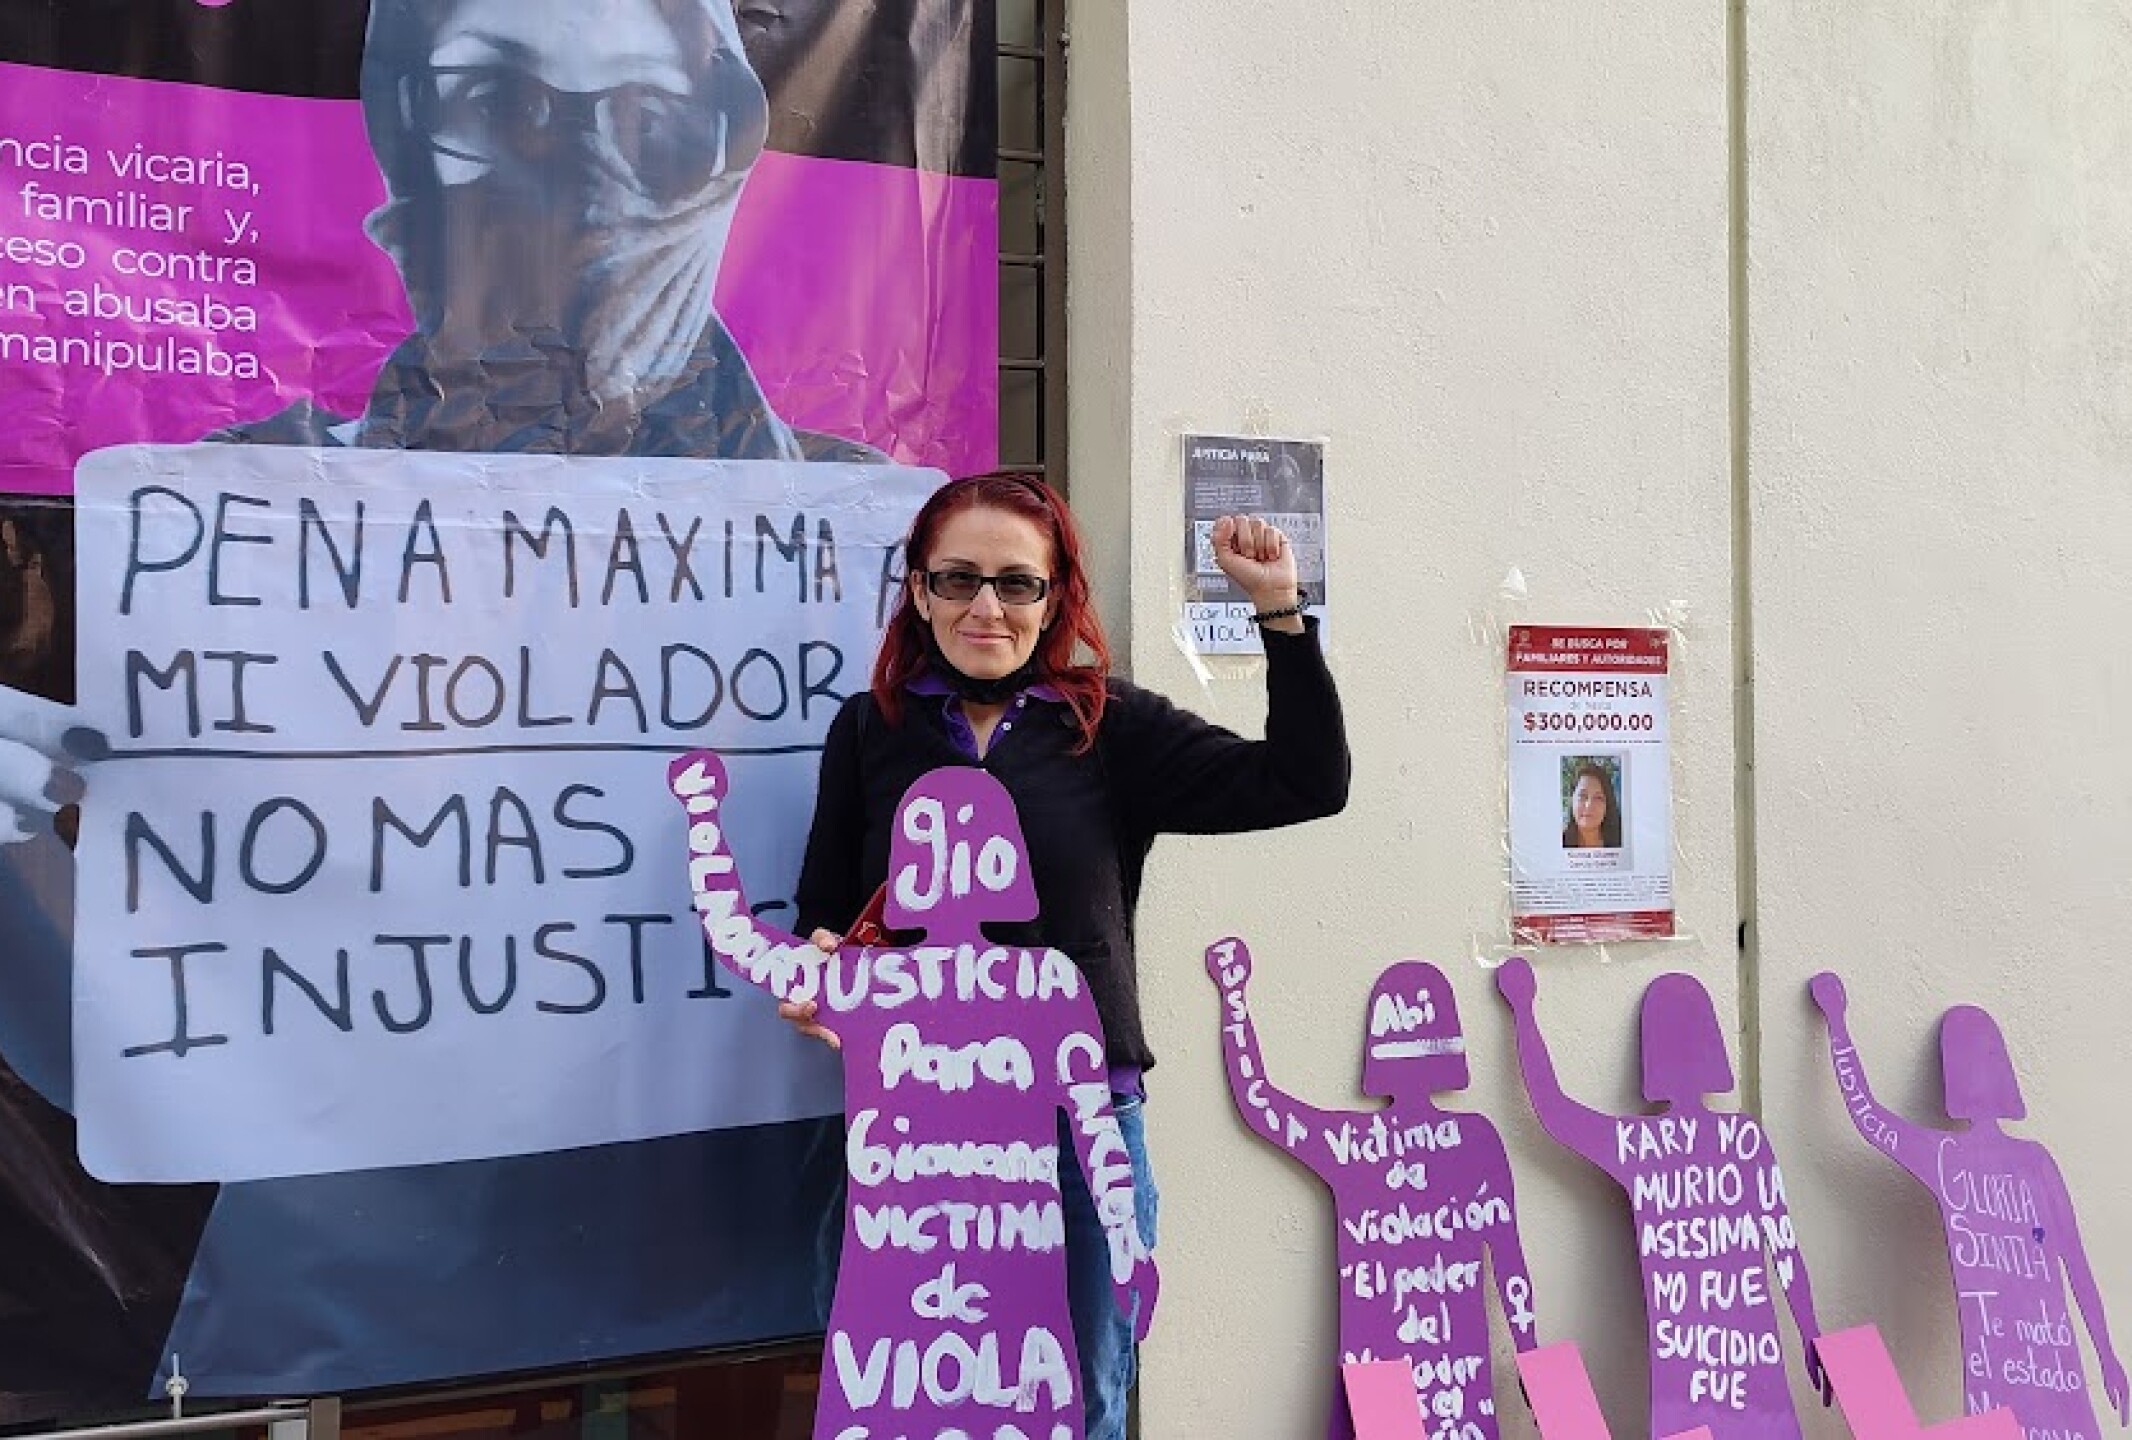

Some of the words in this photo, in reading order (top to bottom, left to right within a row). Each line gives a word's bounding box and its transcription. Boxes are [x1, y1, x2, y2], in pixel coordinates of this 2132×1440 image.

[106, 142, 259, 197] vicaria,
[20, 181, 193, 233] familiar
[224, 208, 259, 245] y,
[0, 236, 85, 269] eso
[112, 248, 256, 286] contra
[63, 283, 256, 332] abusaba
[119, 486, 452, 615] PENA
[502, 506, 842, 607] MAXIMA
[123, 648, 277, 740] MI
[324, 641, 848, 734] VIOLADOR
[1523, 681, 1653, 698] RECOMPENSA
[1523, 711, 1653, 733] $300,000.00
[125, 797, 327, 912] NO
[369, 784, 636, 894] MAS
[895, 795, 1019, 912] gio
[122, 901, 788, 1058] INJUSTI
[788, 942, 1081, 1012] JUSTICIA
[1370, 987, 1437, 1037] Abi
[1615, 1117, 1698, 1165] KARY
[1717, 1115, 1761, 1160] NO
[1633, 1162, 1744, 1215] MURIO
[1393, 1251, 1482, 1313] poder
[1652, 1270, 1688, 1315] NO
[1700, 1266, 1769, 1312] FUE
[1396, 1301, 1451, 1344] del
[1958, 1290, 2006, 1339] Te
[832, 1325, 1075, 1413] VIOLA
[1656, 1319, 1783, 1368] SUICIDIO
[1969, 1335, 1993, 1380] el
[2002, 1348, 2083, 1393] estado
[1689, 1368, 1748, 1411] FUE
